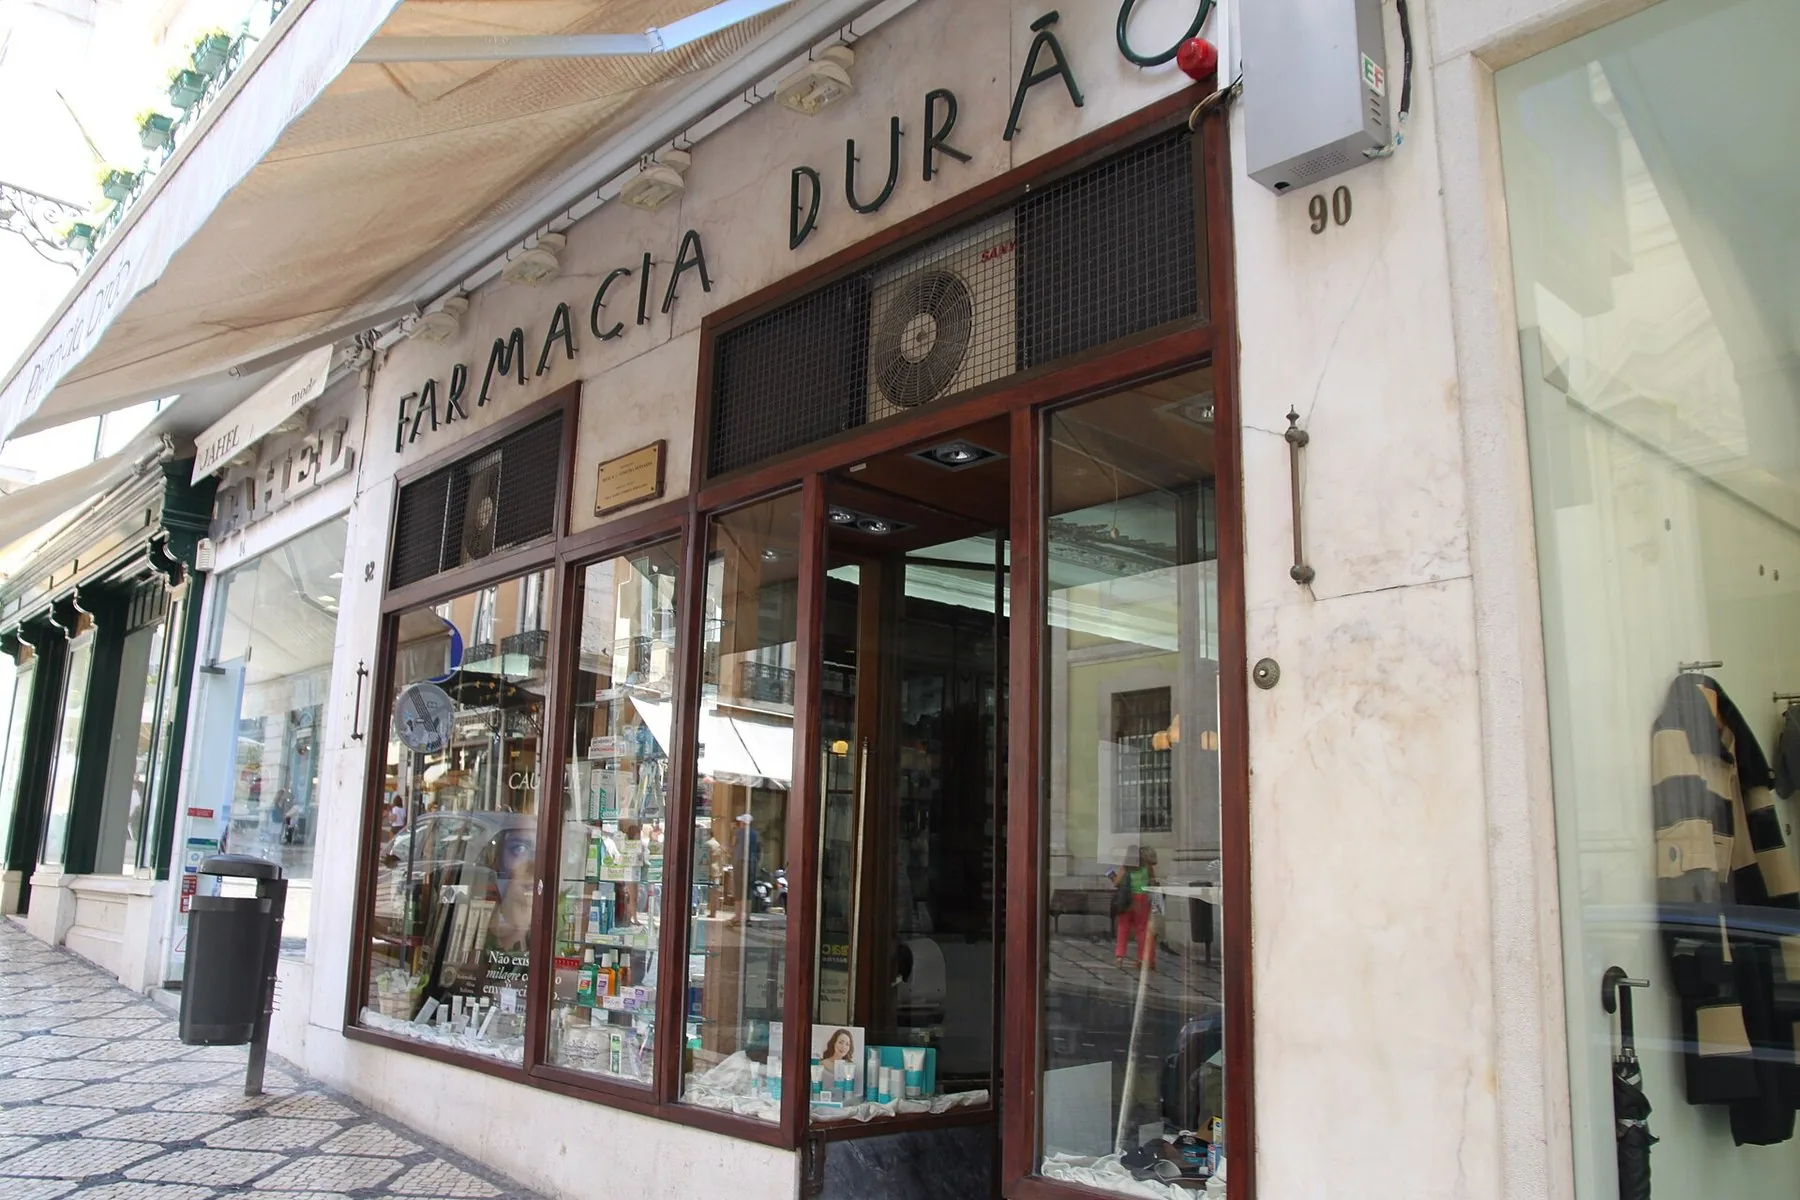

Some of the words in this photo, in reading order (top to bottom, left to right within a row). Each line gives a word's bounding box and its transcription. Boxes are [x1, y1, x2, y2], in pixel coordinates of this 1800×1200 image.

[1363, 57, 1385, 88] EF
[1308, 185, 1353, 235] 90
[396, 229, 714, 453] FARMACIA
[488, 950, 510, 964] Não
[485, 967, 522, 985] milagre
